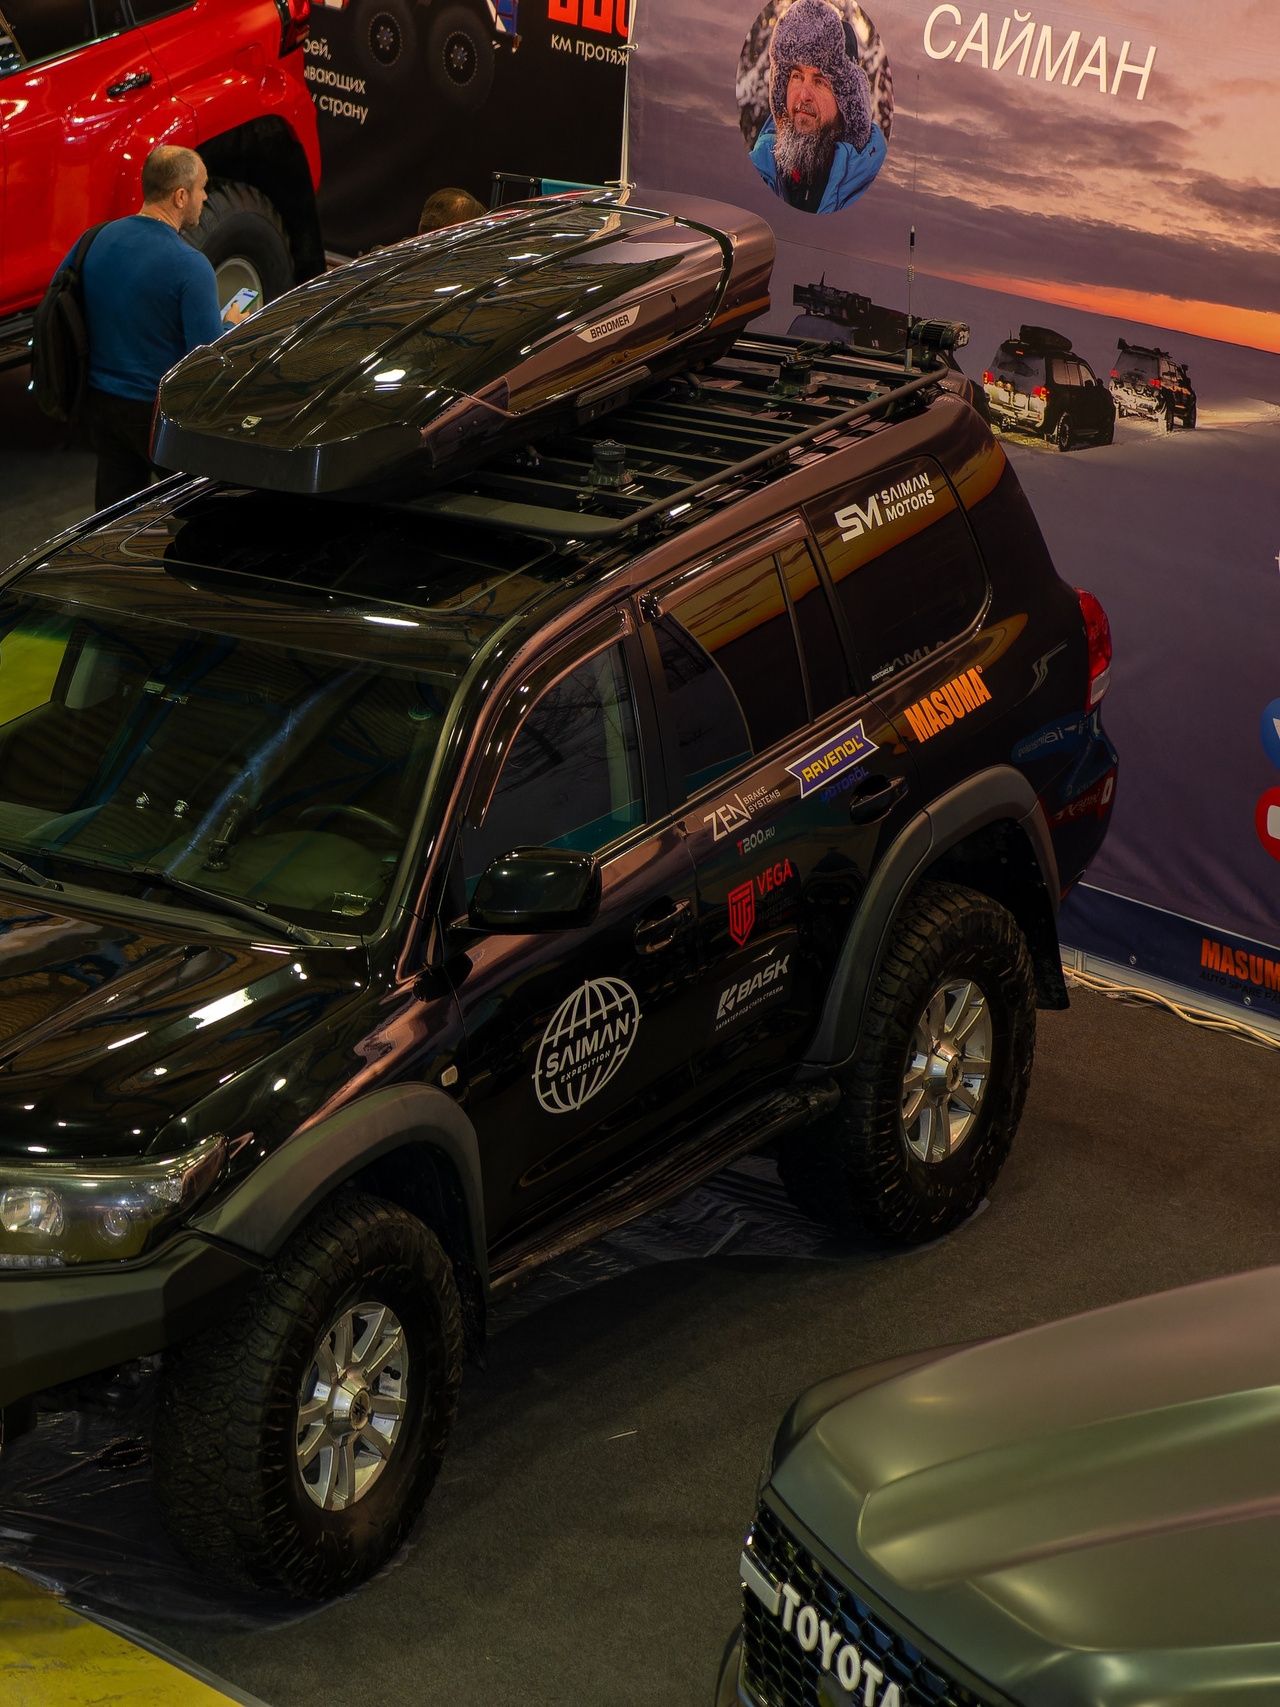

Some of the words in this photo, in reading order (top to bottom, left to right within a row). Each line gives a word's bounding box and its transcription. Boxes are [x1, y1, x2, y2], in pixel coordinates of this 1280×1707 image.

[551, 33, 572, 54] км
[923, 3, 1157, 101] САЙМАН
[318, 94, 369, 125] страну
[589, 314, 630, 339] BROOMER
[880, 472, 930, 505] SAIMAN
[885, 488, 935, 522] MOTORS
[903, 666, 993, 744] MASUMA
[801, 737, 864, 783] RAVENOL
[742, 785, 768, 805] BRAKE
[747, 789, 781, 814] SYSTEMS
[703, 793, 752, 842] ZEN
[736, 826, 776, 856] T200.RU
[756, 858, 794, 896] VEGA
[736, 954, 791, 1003] BASK
[1198, 970, 1227, 986] AUTO
[545, 1012, 630, 1078] SAIMAN
[560, 1049, 611, 1084] EXPEDITION
